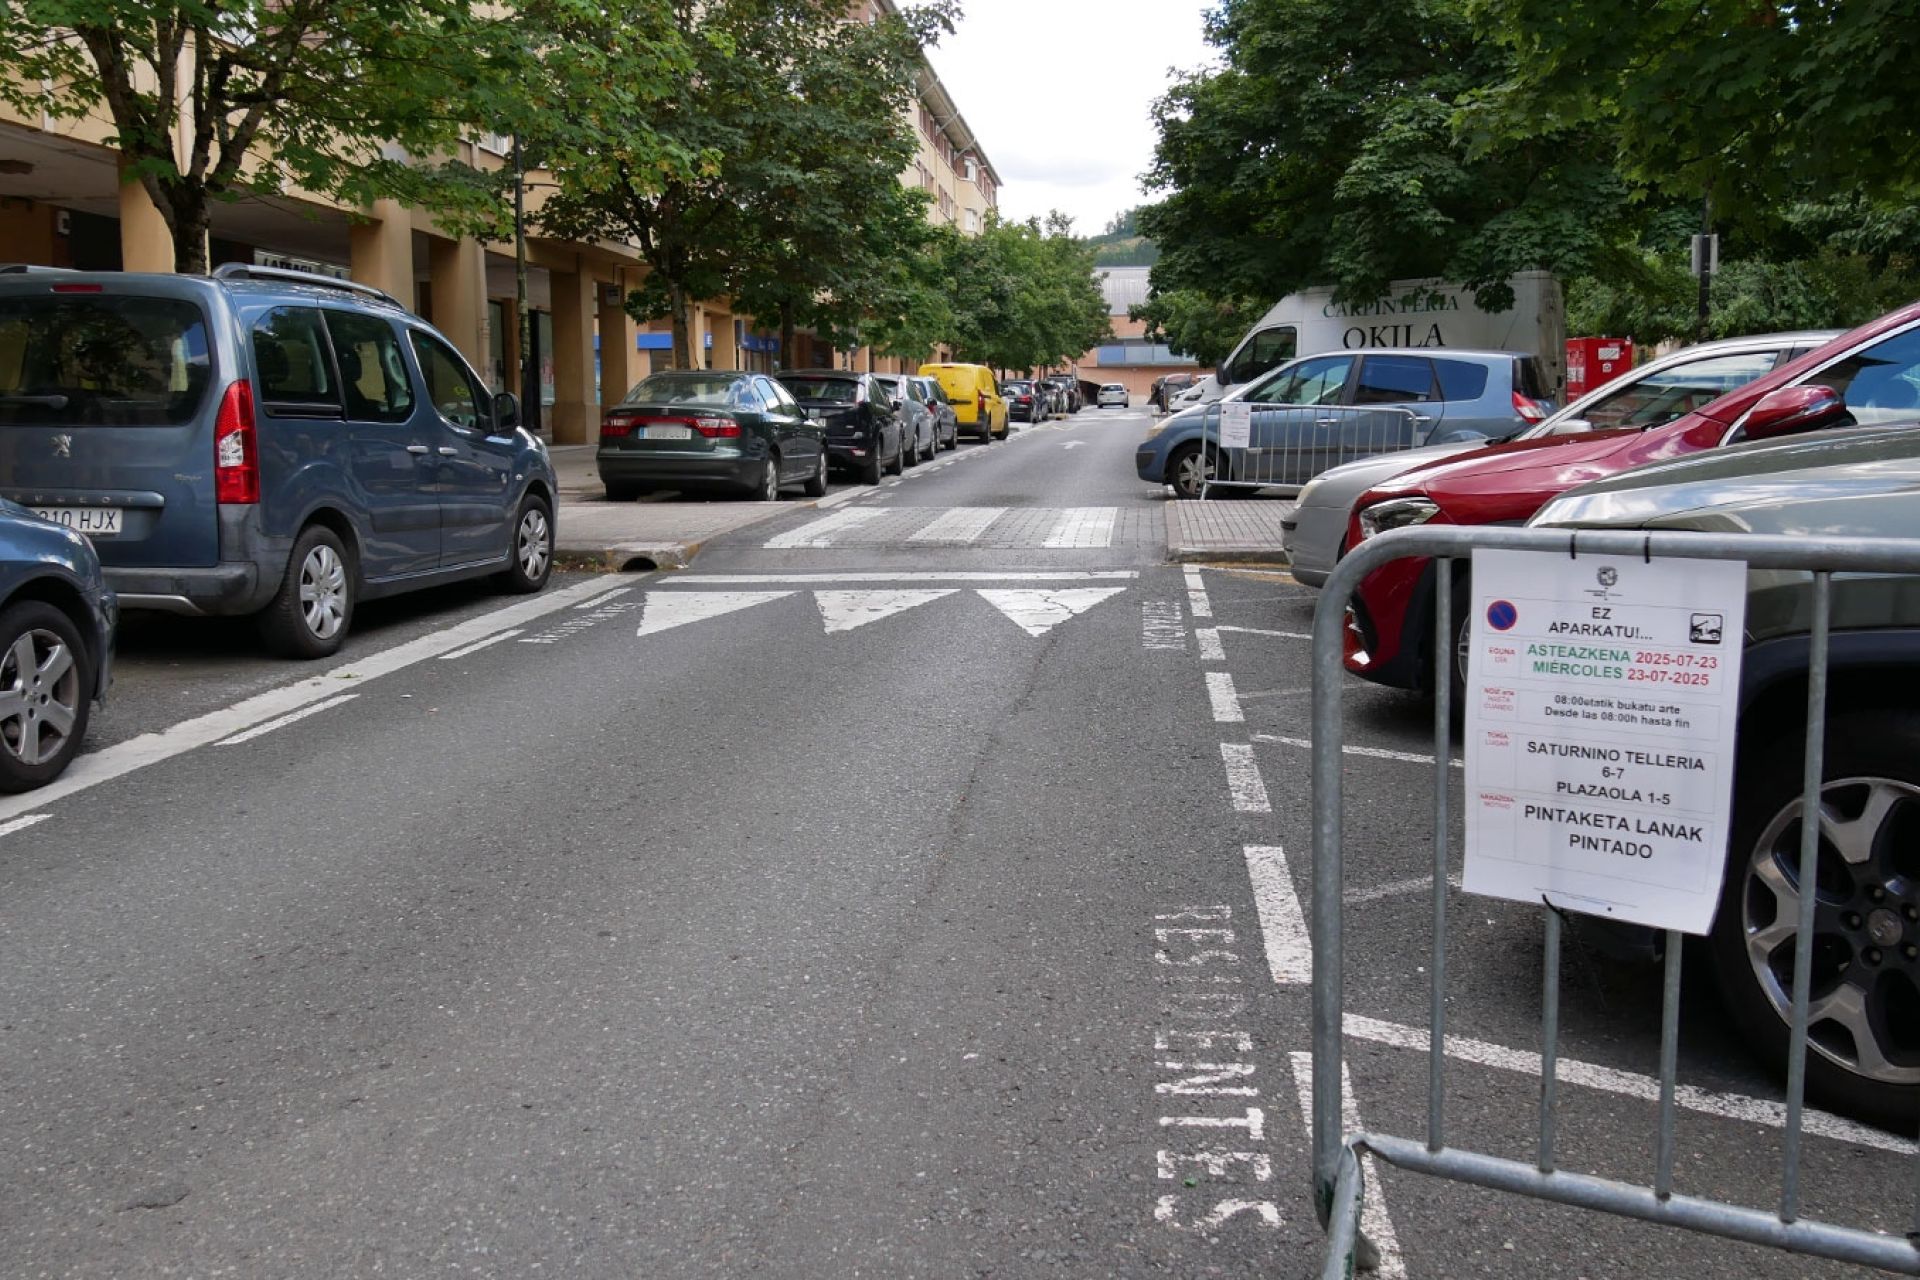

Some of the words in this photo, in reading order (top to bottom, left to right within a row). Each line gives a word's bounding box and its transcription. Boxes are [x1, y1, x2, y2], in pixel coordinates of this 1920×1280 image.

[1342, 323, 1447, 348] OKILA
[80, 511, 116, 531] HJX
[1592, 607, 1611, 620] EZ
[1548, 622, 1653, 640] APARKATU!...
[1527, 644, 1631, 663] ASTEAZKENA
[1635, 651, 1718, 669] 2025-07-23
[1532, 659, 1623, 680] MIÉRCOLES
[1627, 669, 1710, 686] 23-07-2025
[1544, 706, 1579, 718] Desde
[1582, 710, 1598, 720] las
[1601, 711, 1638, 724] 08:00h
[1641, 715, 1672, 728] hasta
[1674, 719, 1690, 729] fin
[1617, 701, 1656, 712] bukatu
[1658, 705, 1681, 715] arte
[1527, 741, 1621, 762] SATURNINO
[1625, 751, 1705, 771] TELLERIA
[1602, 766, 1625, 780] 6-7
[1556, 781, 1642, 802] PLAZAOLA
[1648, 791, 1671, 805] 1-5
[1524, 805, 1630, 831] PINTAKETA
[1636, 820, 1703, 842] LANAK
[1569, 834, 1653, 859] PINTADO
